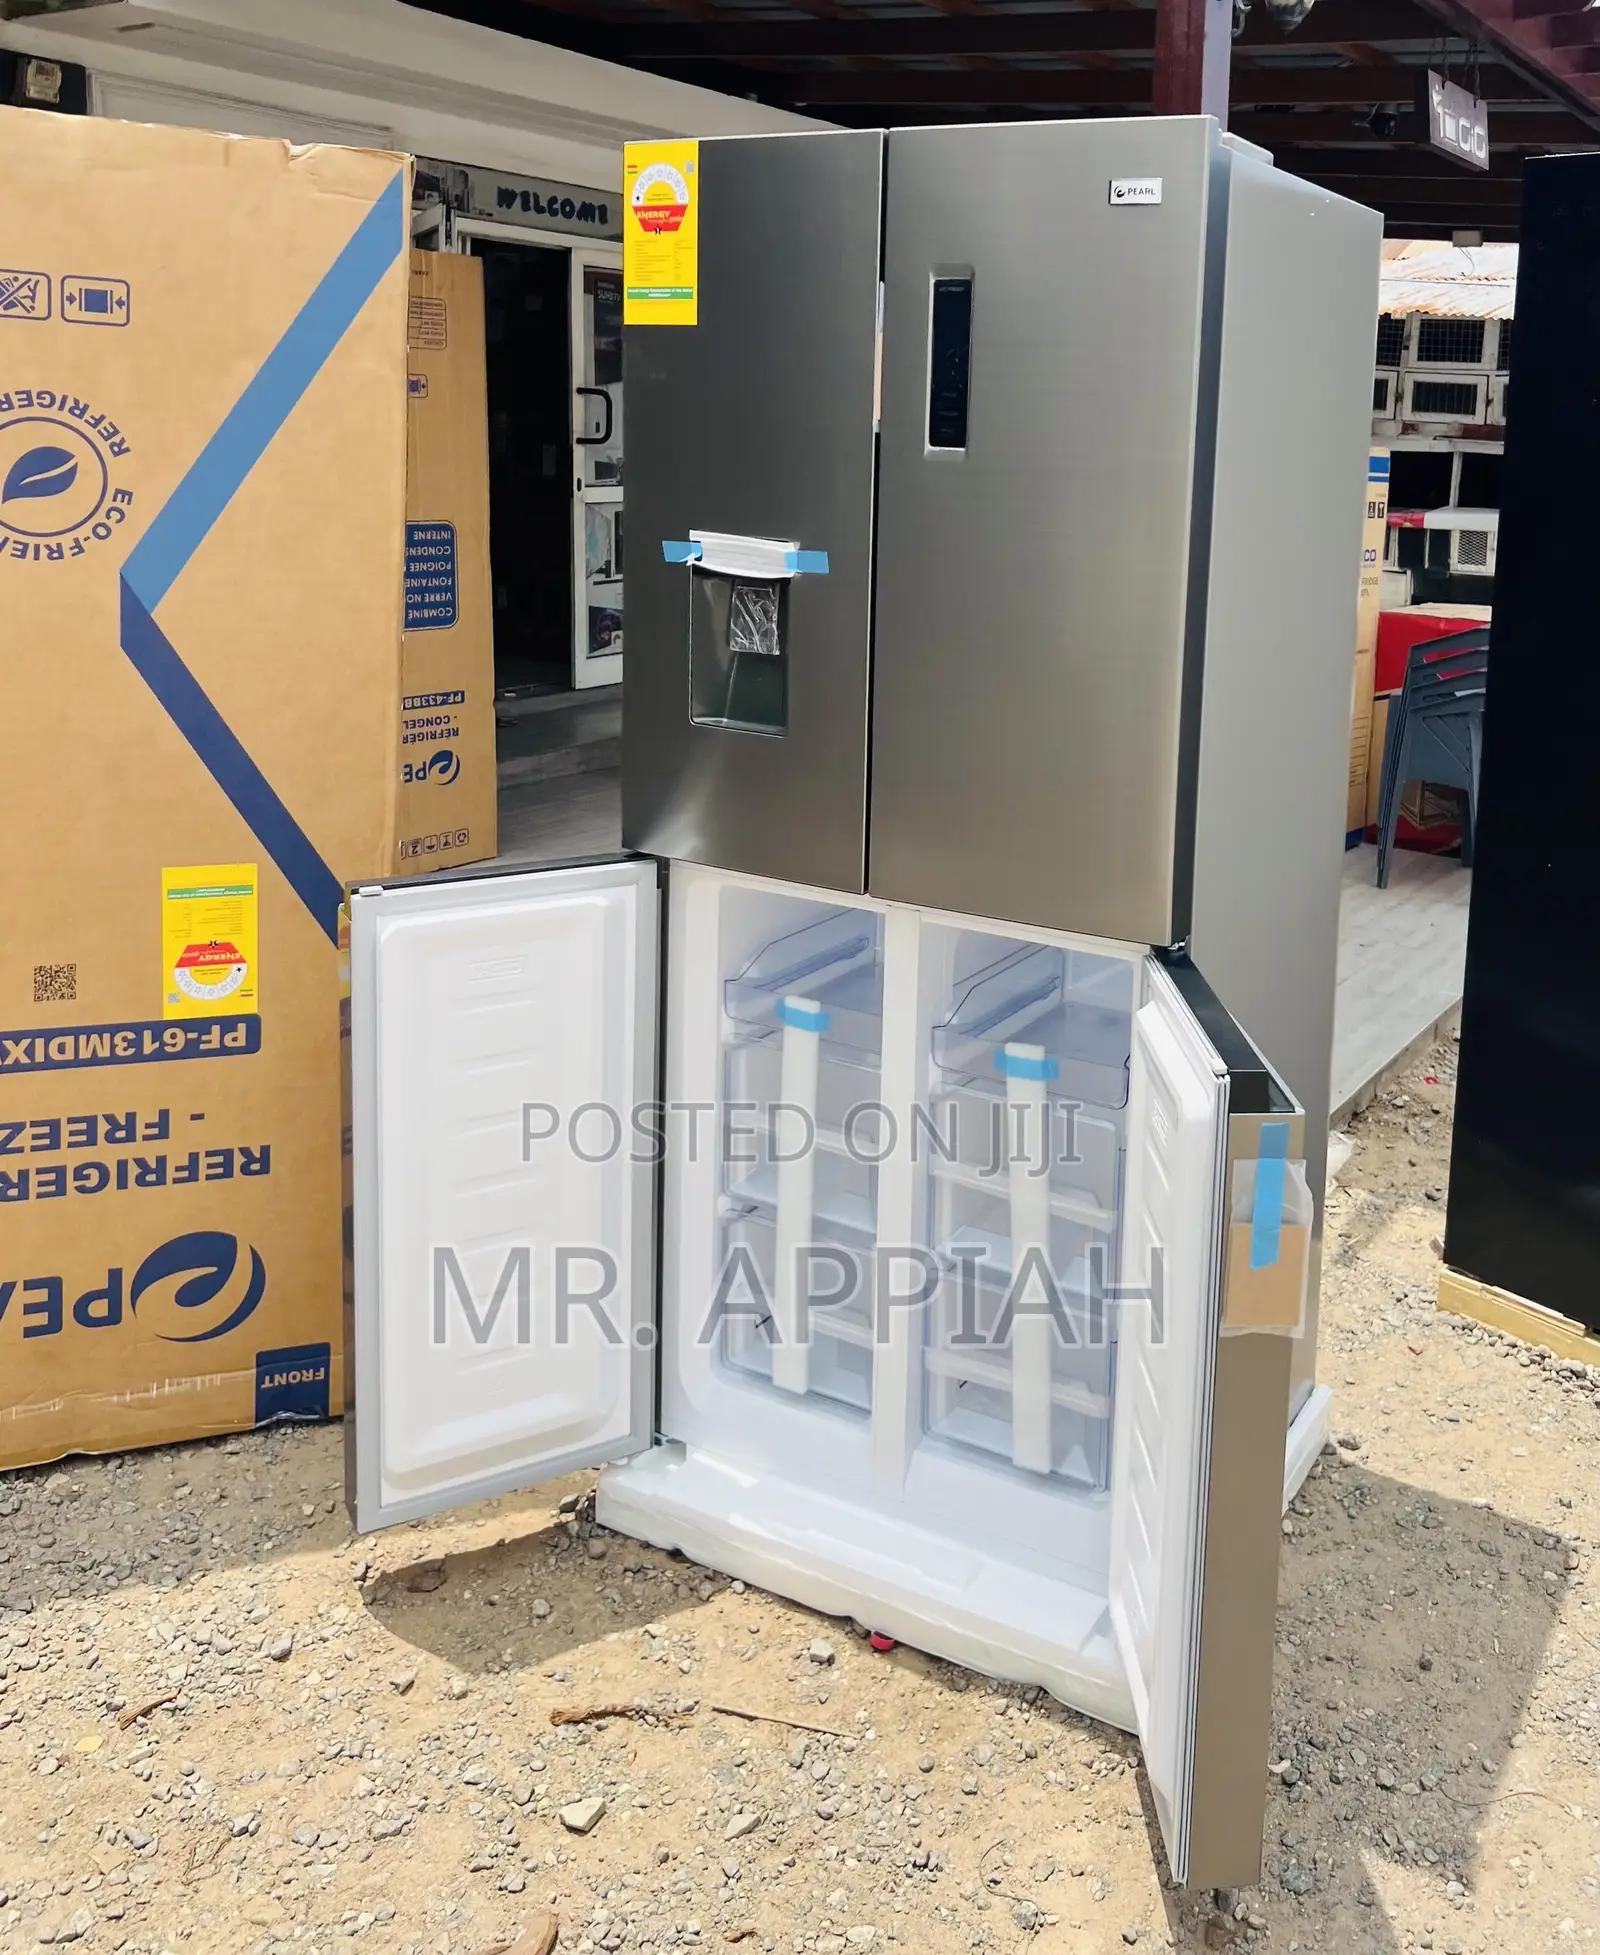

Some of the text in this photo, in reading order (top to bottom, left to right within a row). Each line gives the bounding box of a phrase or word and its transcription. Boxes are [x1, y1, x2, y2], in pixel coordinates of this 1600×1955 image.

[1127, 187, 1156, 196] PEARL
[497, 185, 609, 226] WELCOME
[637, 209, 671, 220] ENERGY
[413, 530, 451, 540] INTERNE
[405, 576, 452, 588] FONTAINE
[424, 592, 453, 602] VERRE
[408, 606, 453, 621] COMBINÉ
[402, 714, 451, 729] CONGEL
[198, 951, 241, 962] ENERGY
[0, 1021, 247, 1066] PF-613MDIX
[0, 1144, 271, 1203] REFRIGER
[261, 1366, 326, 1389] FRONT
